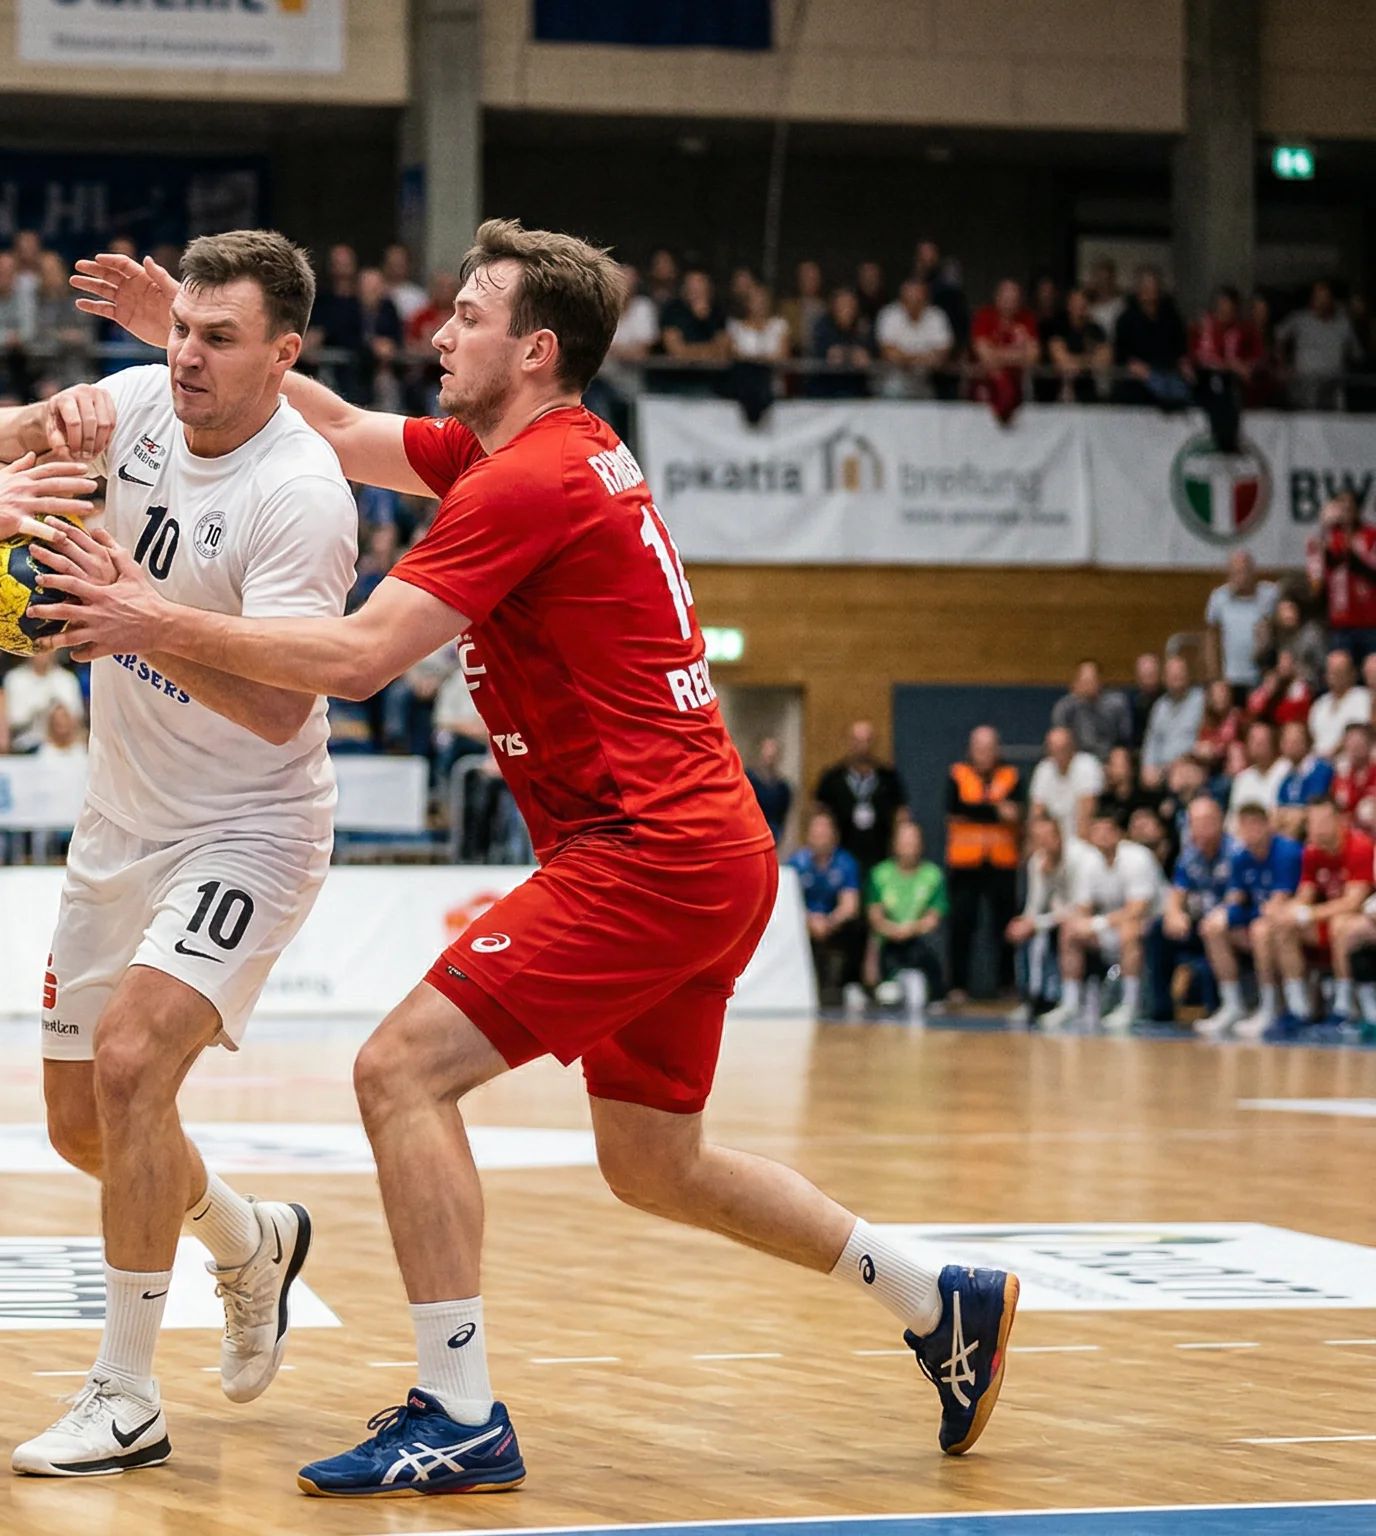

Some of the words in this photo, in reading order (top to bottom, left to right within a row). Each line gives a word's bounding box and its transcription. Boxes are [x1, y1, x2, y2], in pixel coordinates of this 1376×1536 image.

[133, 505, 180, 580] 10
[203, 523, 222, 548] 10
[186, 880, 255, 951] 10
